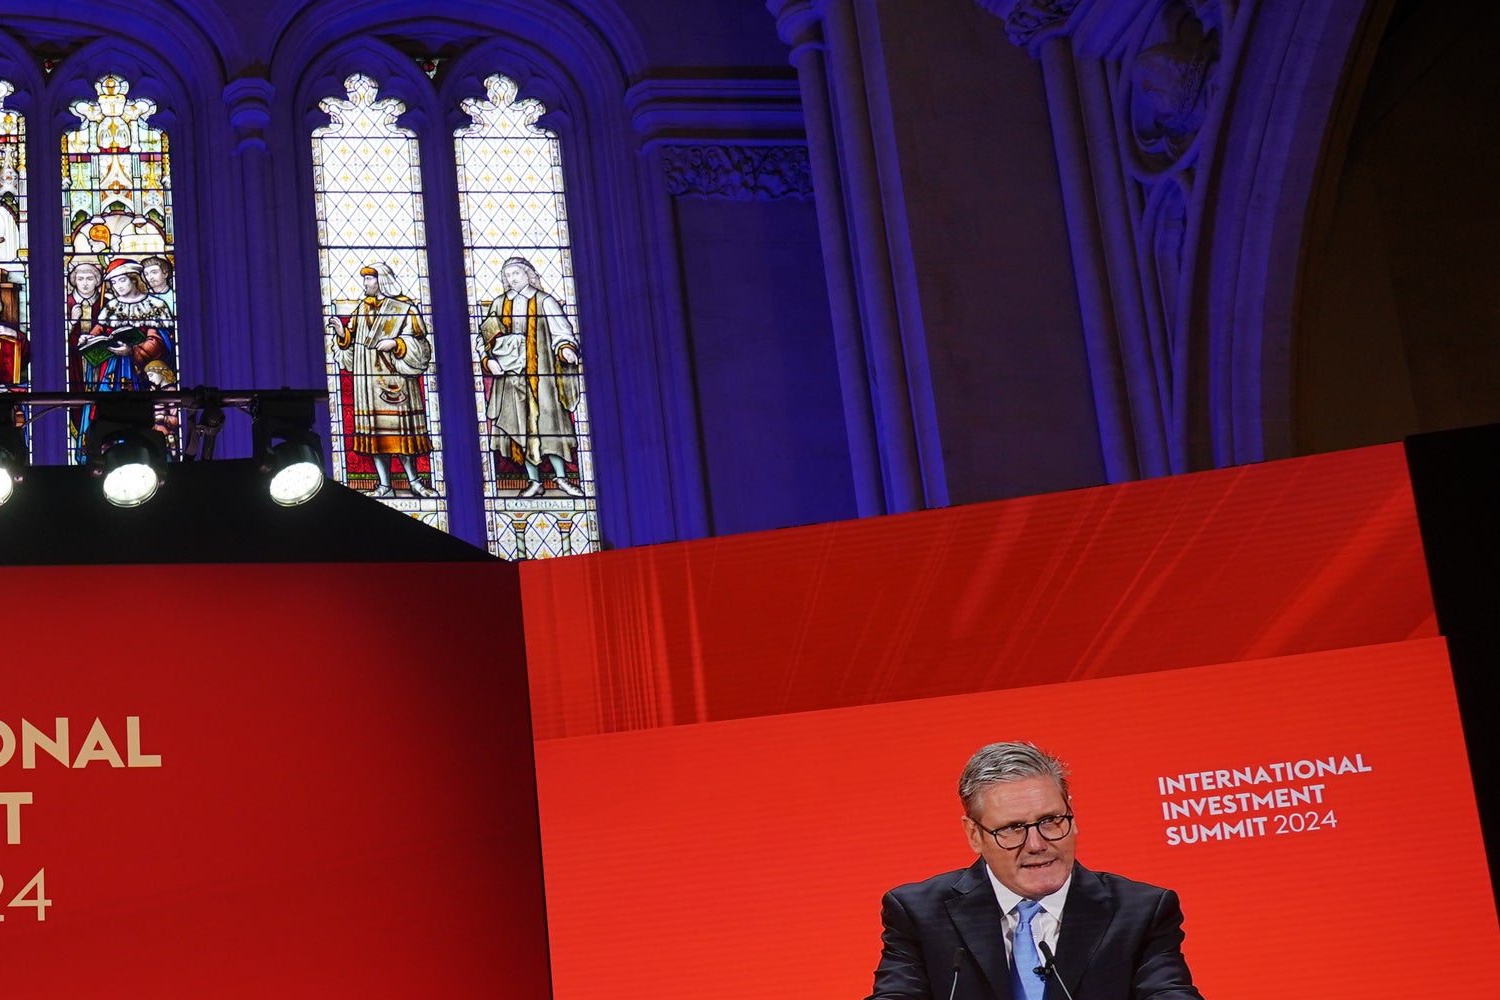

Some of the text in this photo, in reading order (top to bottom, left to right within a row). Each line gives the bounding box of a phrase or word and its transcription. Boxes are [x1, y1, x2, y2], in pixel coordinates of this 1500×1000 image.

[507, 500, 573, 508] COVERDALE
[1158, 753, 1372, 795] INTERNATIONAL
[1162, 784, 1325, 820] INVESTMENT
[1166, 810, 1338, 846] SUMMIT 2024
